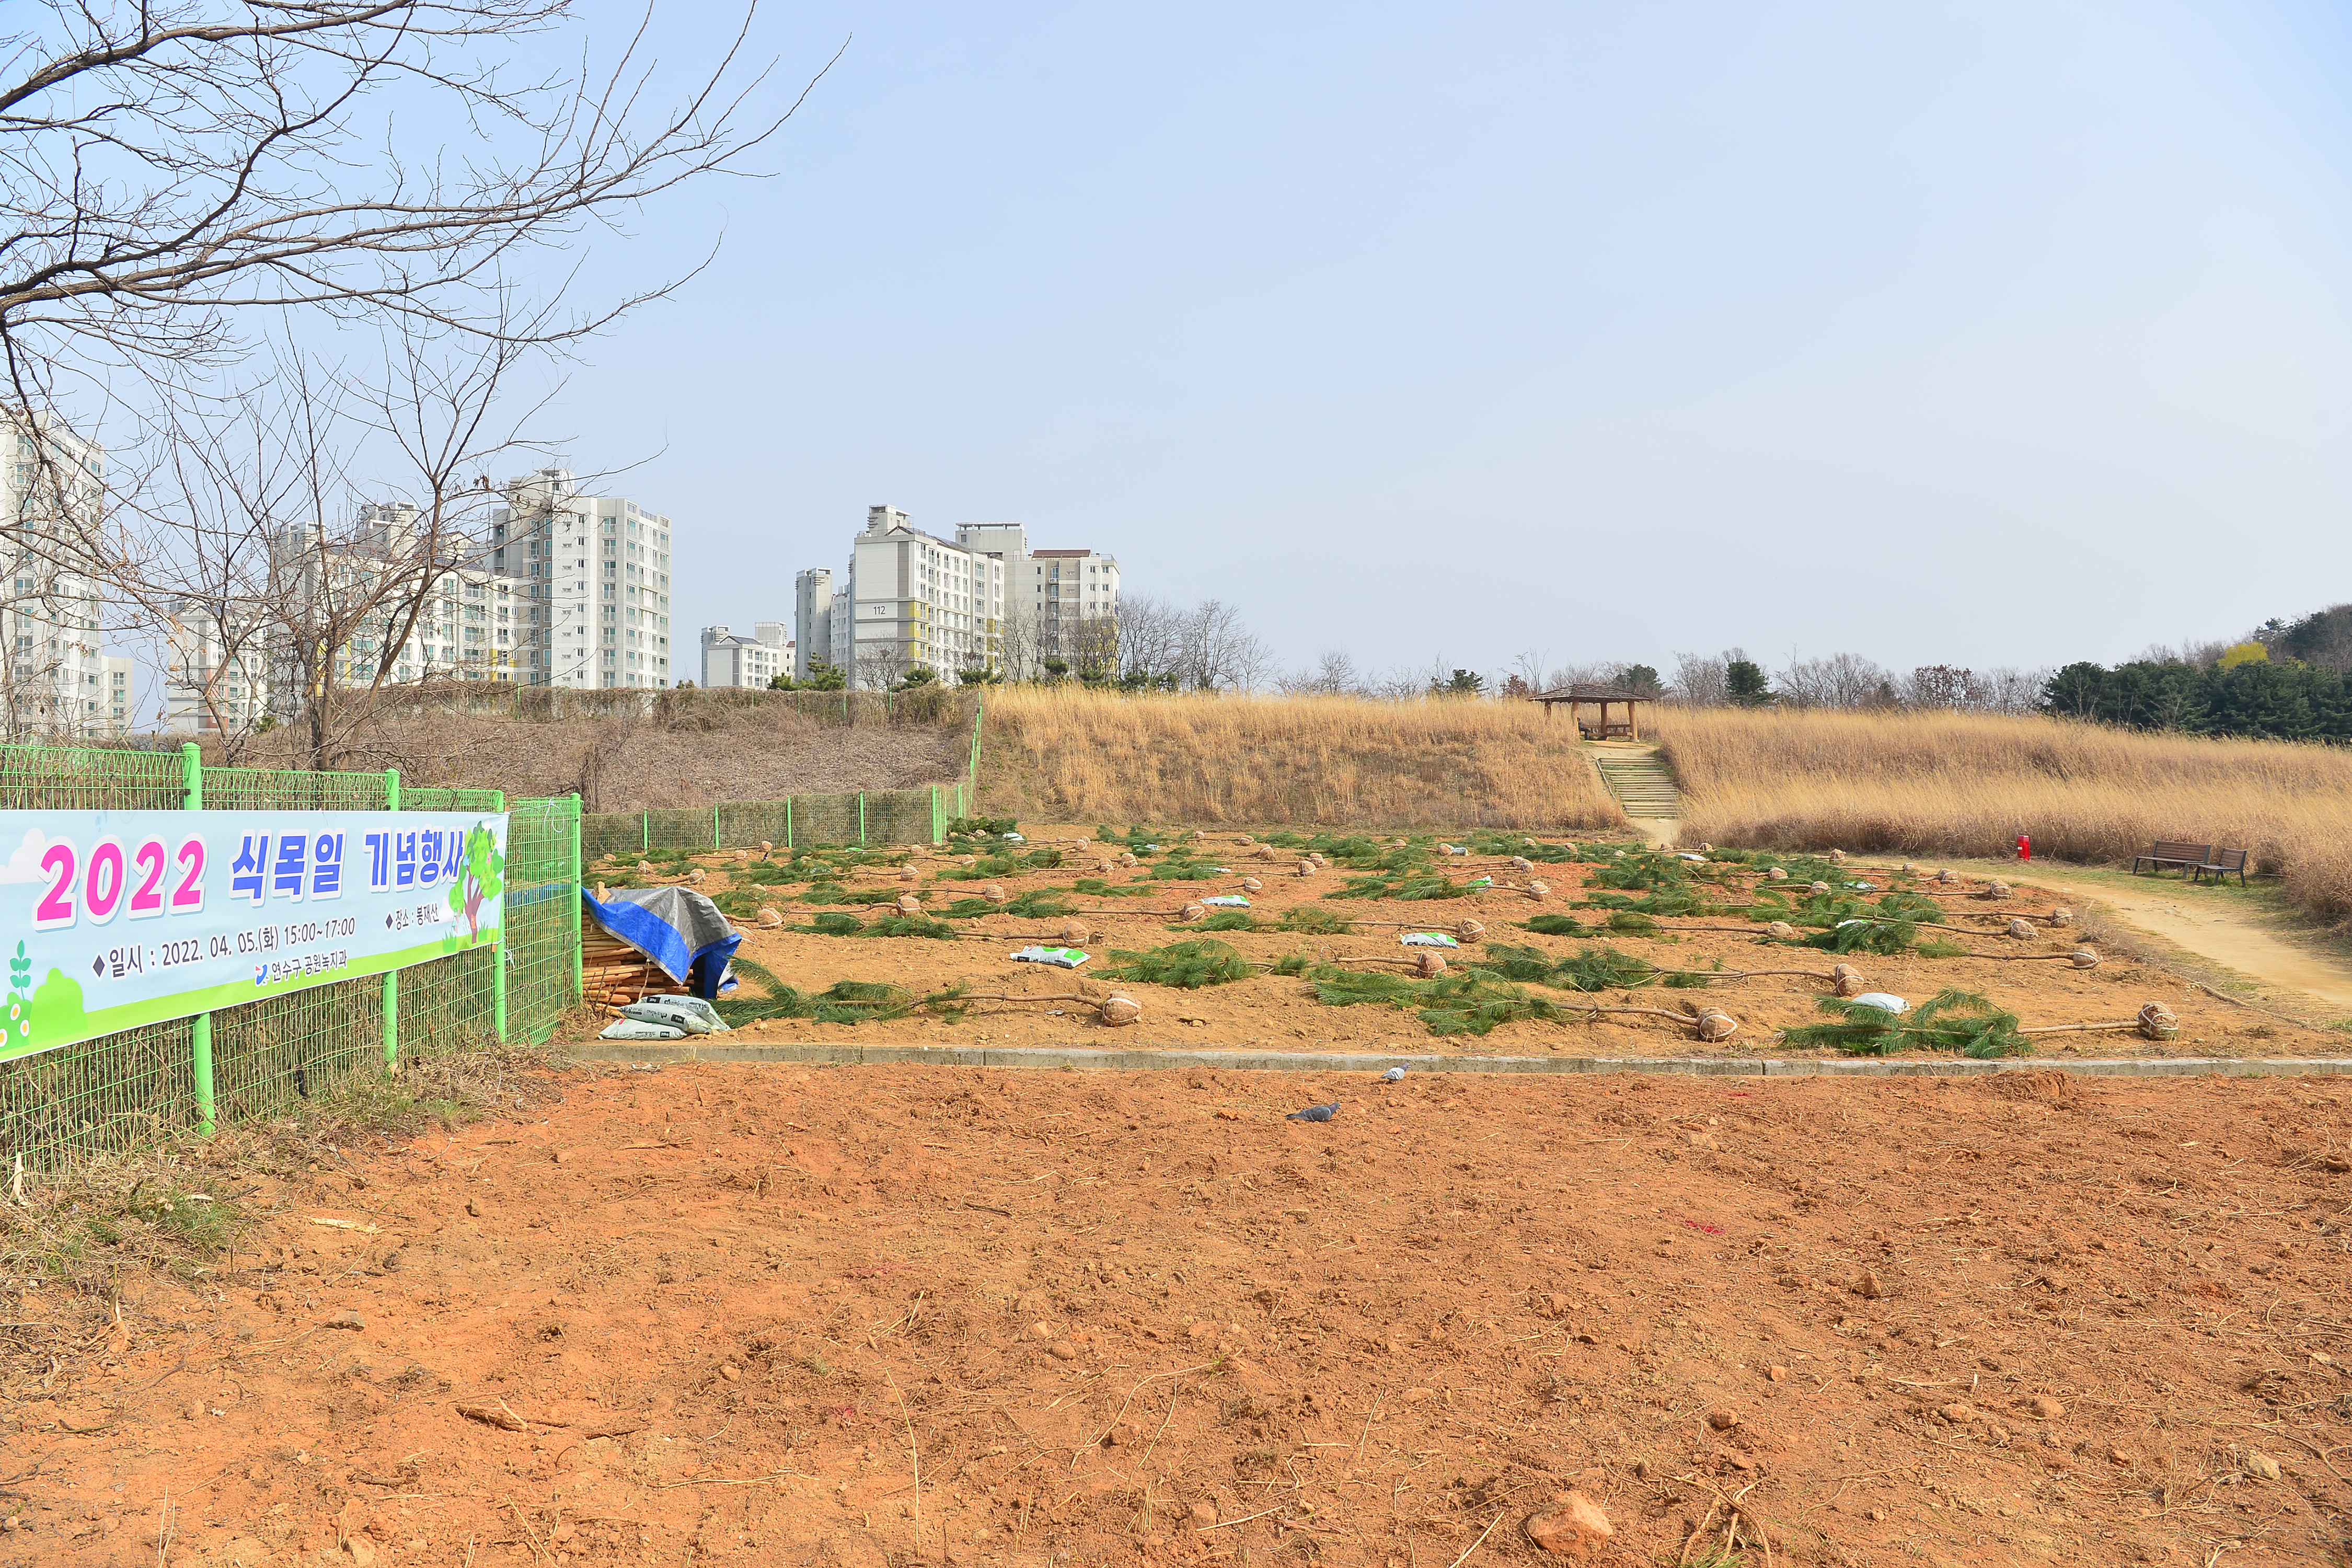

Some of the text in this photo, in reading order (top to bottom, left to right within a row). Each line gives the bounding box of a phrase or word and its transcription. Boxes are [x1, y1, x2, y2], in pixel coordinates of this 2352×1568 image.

[873, 606, 885, 615] 112
[37, 829, 463, 921] 2022 식목일 기념행사
[396, 908, 409, 930] 장소
[417, 903, 439, 926] 봉재산
[109, 945, 143, 977] 일시
[162, 939, 203, 966] 2022.
[210, 935, 232, 958] 04.
[238, 926, 279, 953] 05.(화)
[284, 917, 355, 945] 15:00~17:00
[272, 949, 347, 982] 연수구 공원녹지과
